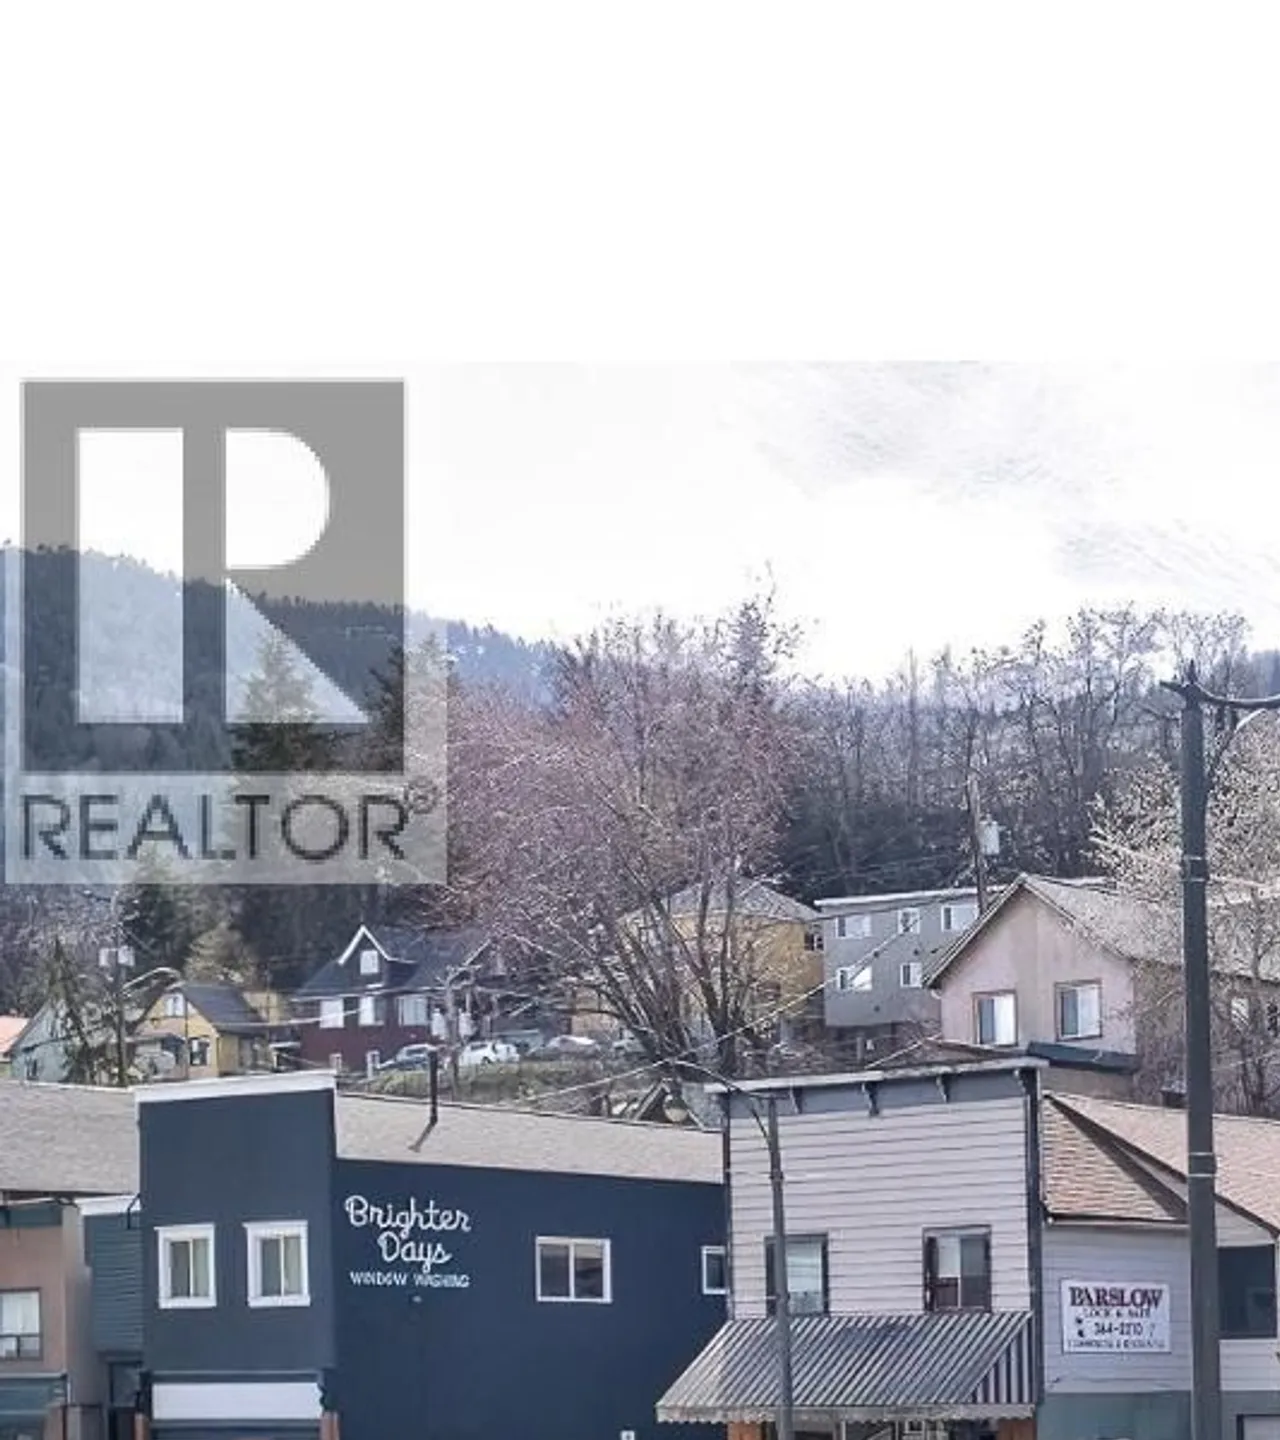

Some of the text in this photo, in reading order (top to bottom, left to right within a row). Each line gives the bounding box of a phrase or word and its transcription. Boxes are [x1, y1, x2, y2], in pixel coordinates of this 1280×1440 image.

[345, 1195, 471, 1239] Brighter
[377, 1231, 452, 1274] Days
[350, 1271, 407, 1286] WINDOW
[1069, 1286, 1162, 1308] PARSLOW
